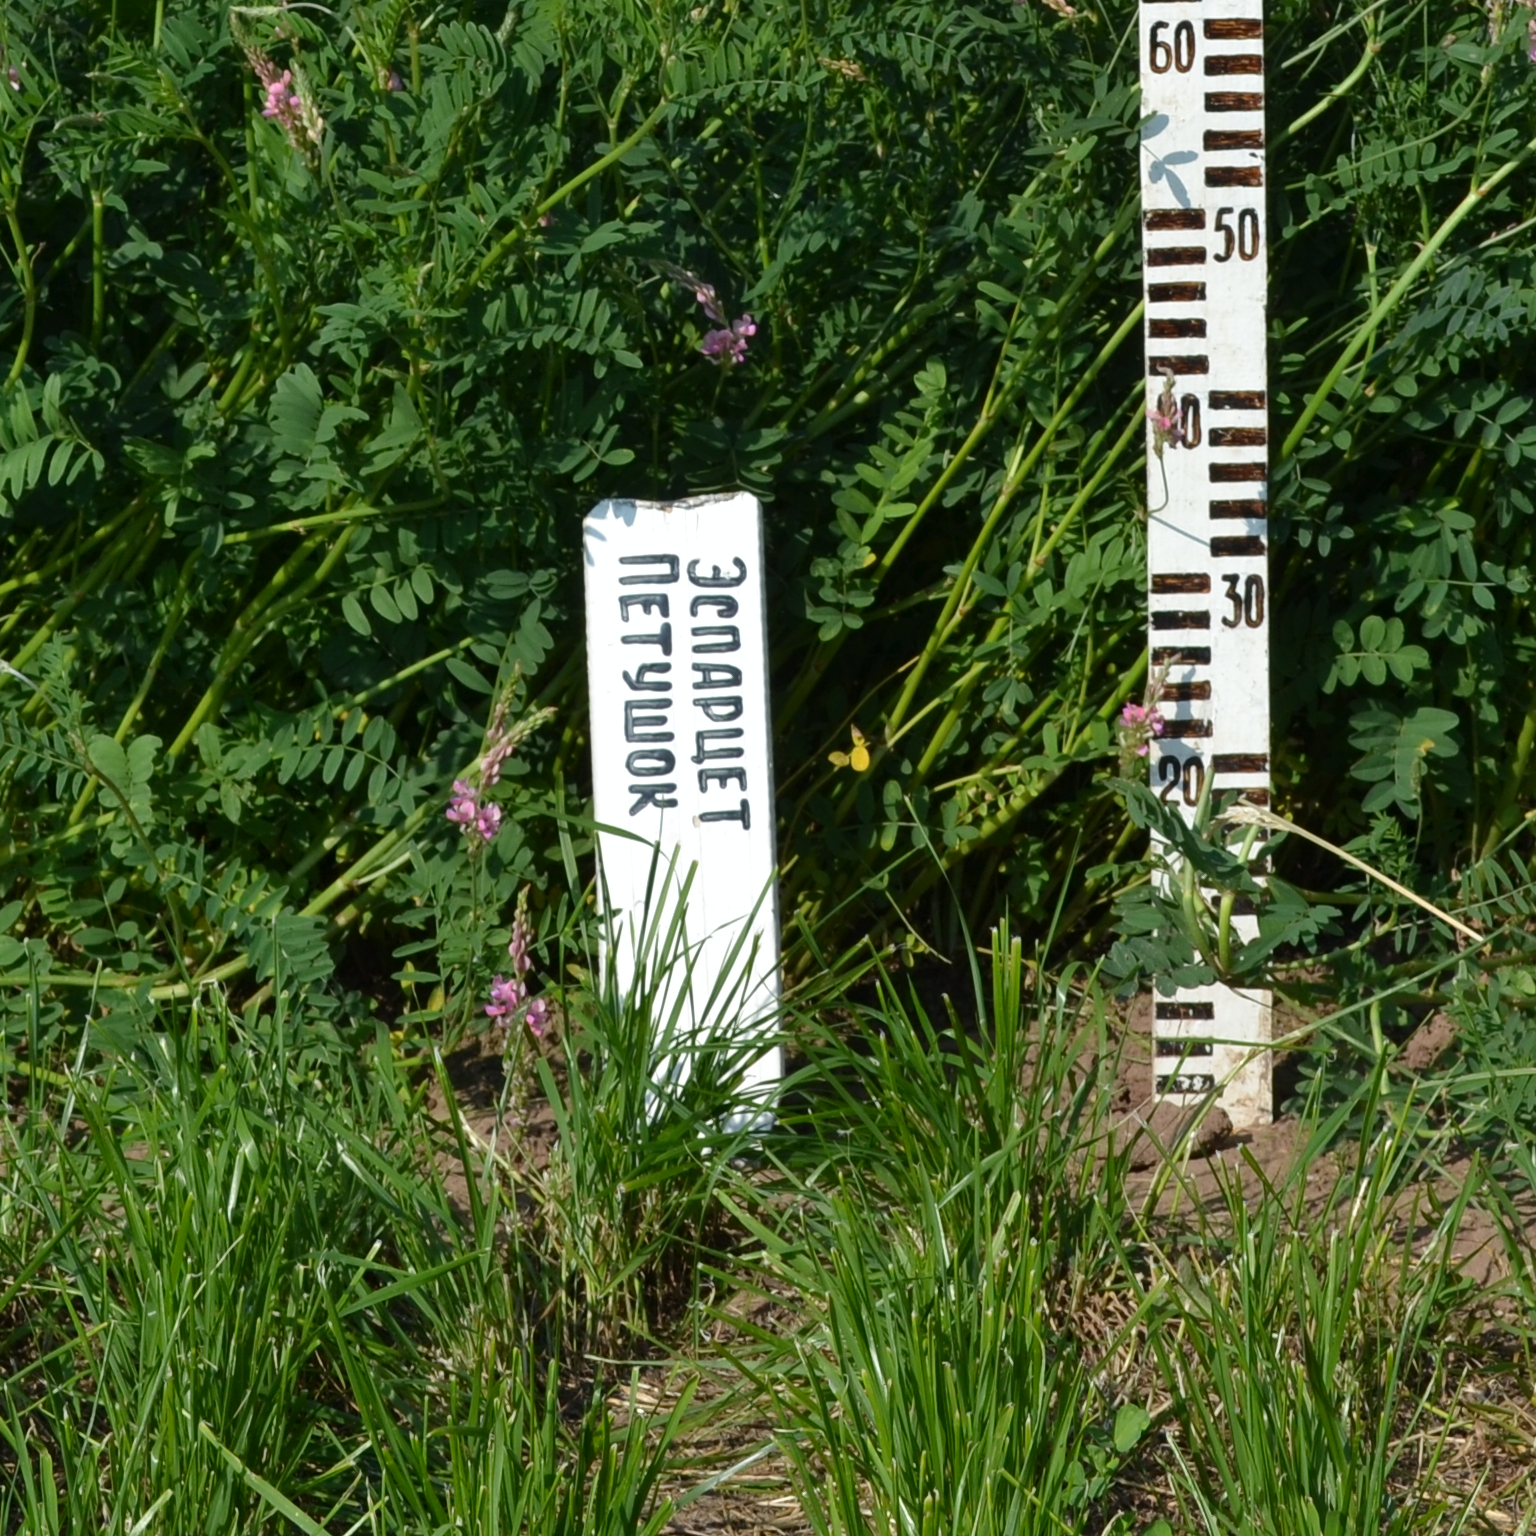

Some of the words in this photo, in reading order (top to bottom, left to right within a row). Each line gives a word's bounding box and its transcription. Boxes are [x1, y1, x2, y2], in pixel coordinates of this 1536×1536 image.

[1149, 20, 1195, 74] 60
[1214, 207, 1260, 262] 50
[1157, 392, 1201, 449] 0
[1221, 574, 1265, 630] 30
[618, 553, 679, 817] ПЕТУШОК
[687, 555, 751, 830] ЭСПАРЦЕТ
